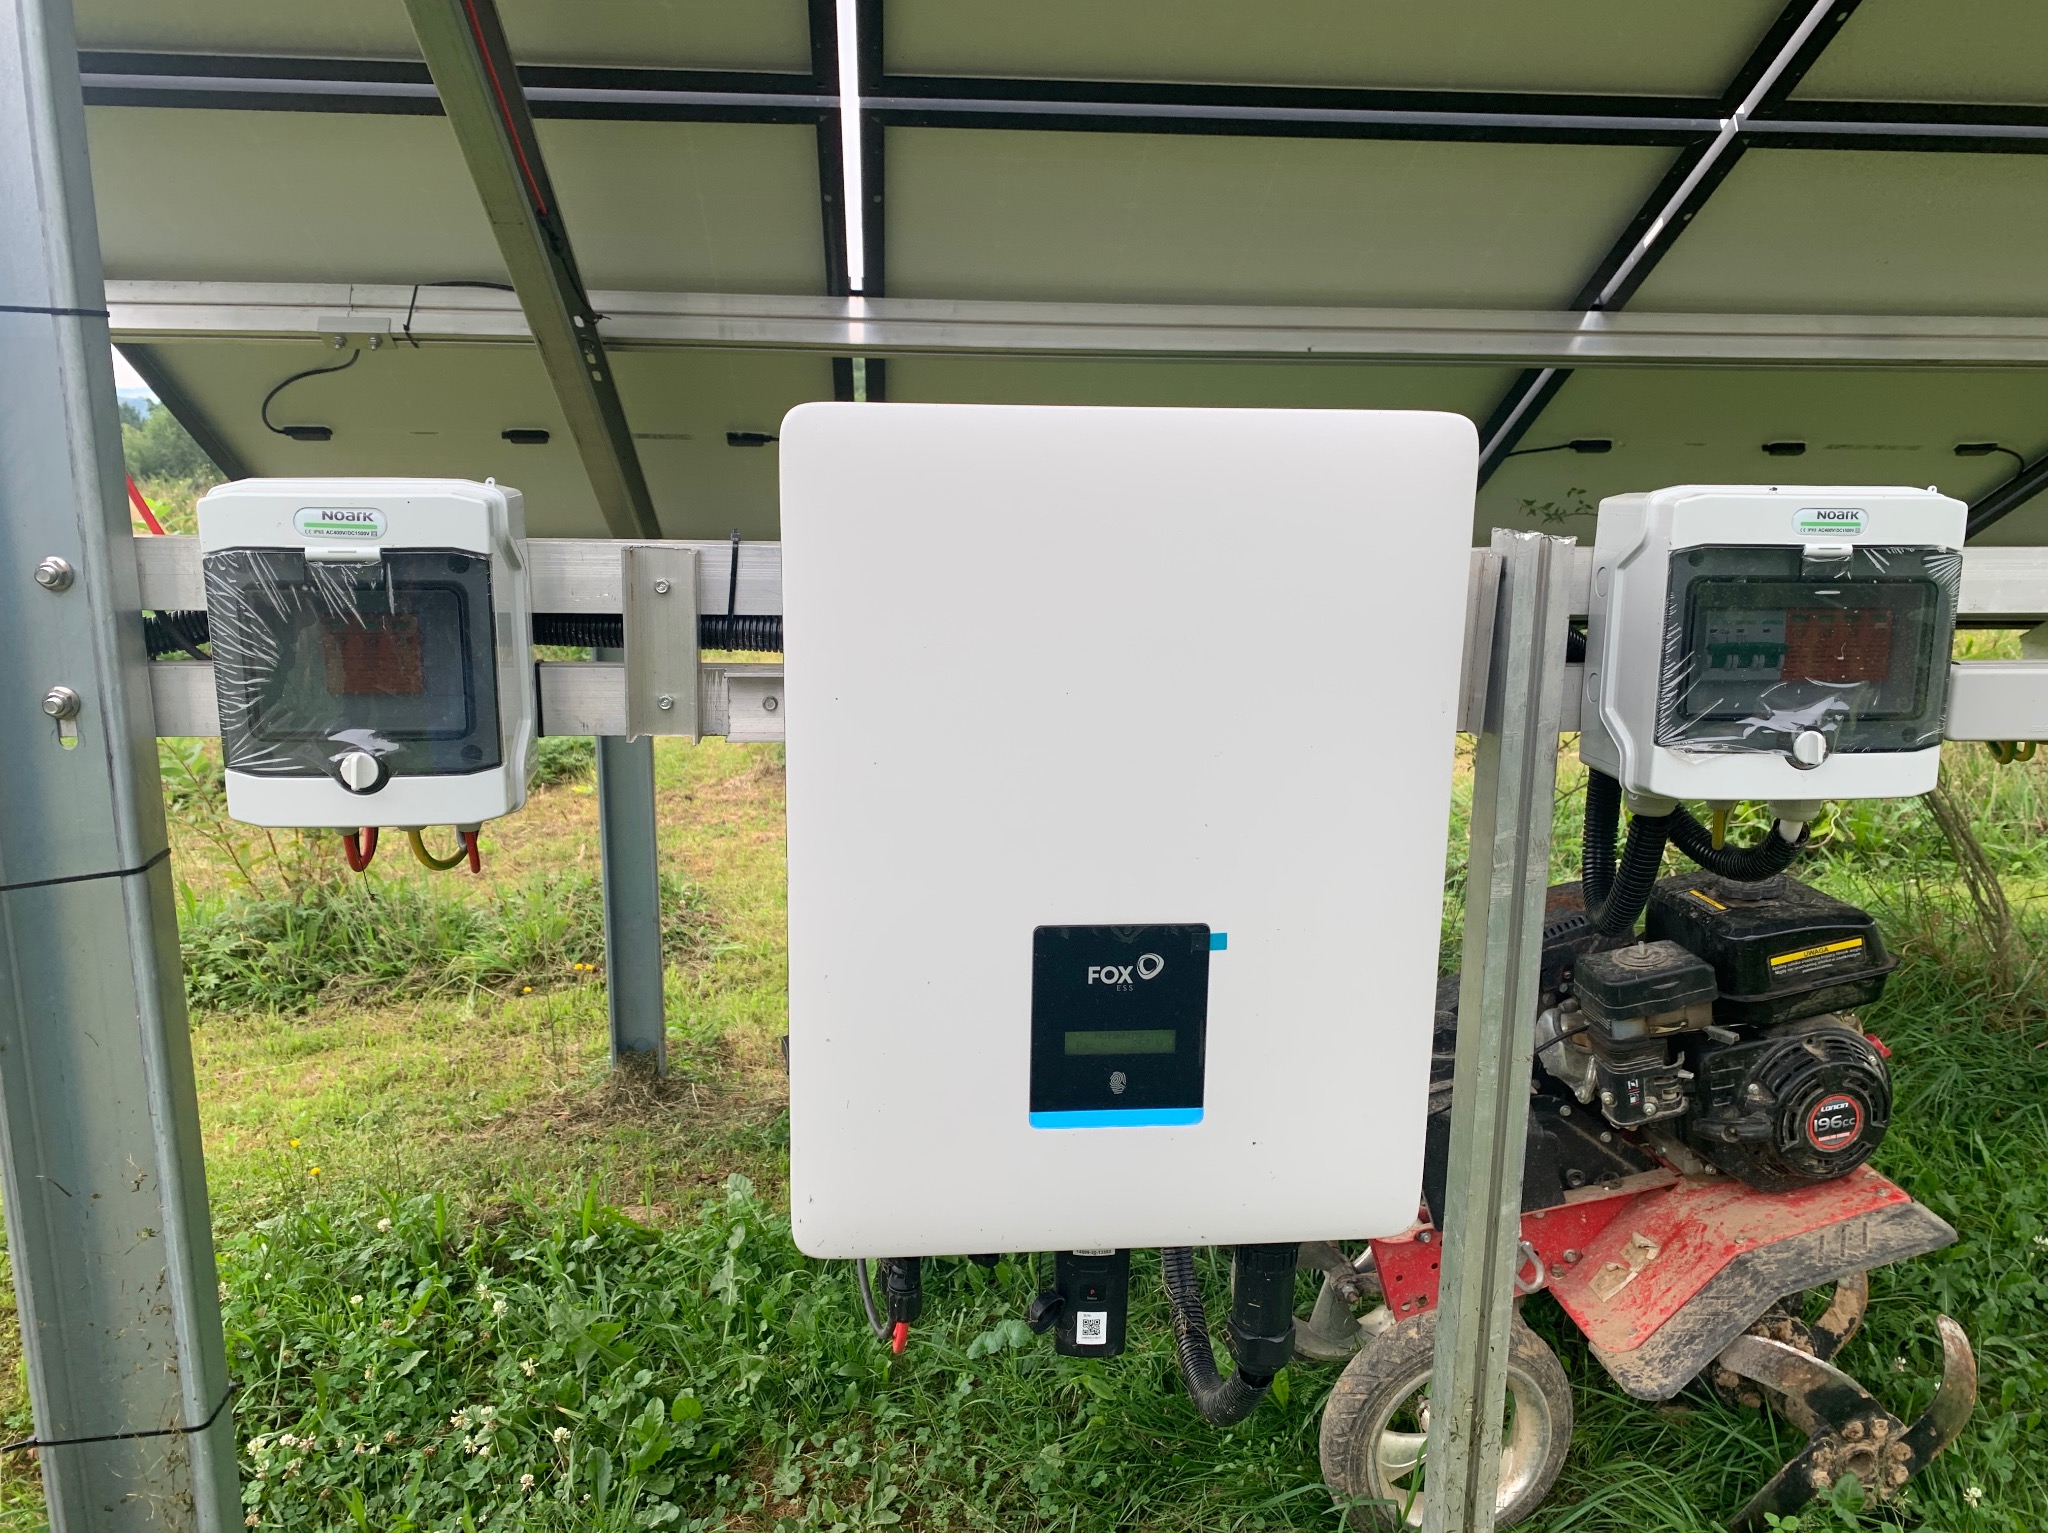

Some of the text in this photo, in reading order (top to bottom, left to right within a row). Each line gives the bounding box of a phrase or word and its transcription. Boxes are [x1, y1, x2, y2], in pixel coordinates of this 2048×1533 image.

[1803, 946, 1829, 957] UWAGA
[1087, 965, 1134, 985] FOX
[1116, 984, 1134, 992] ESS
